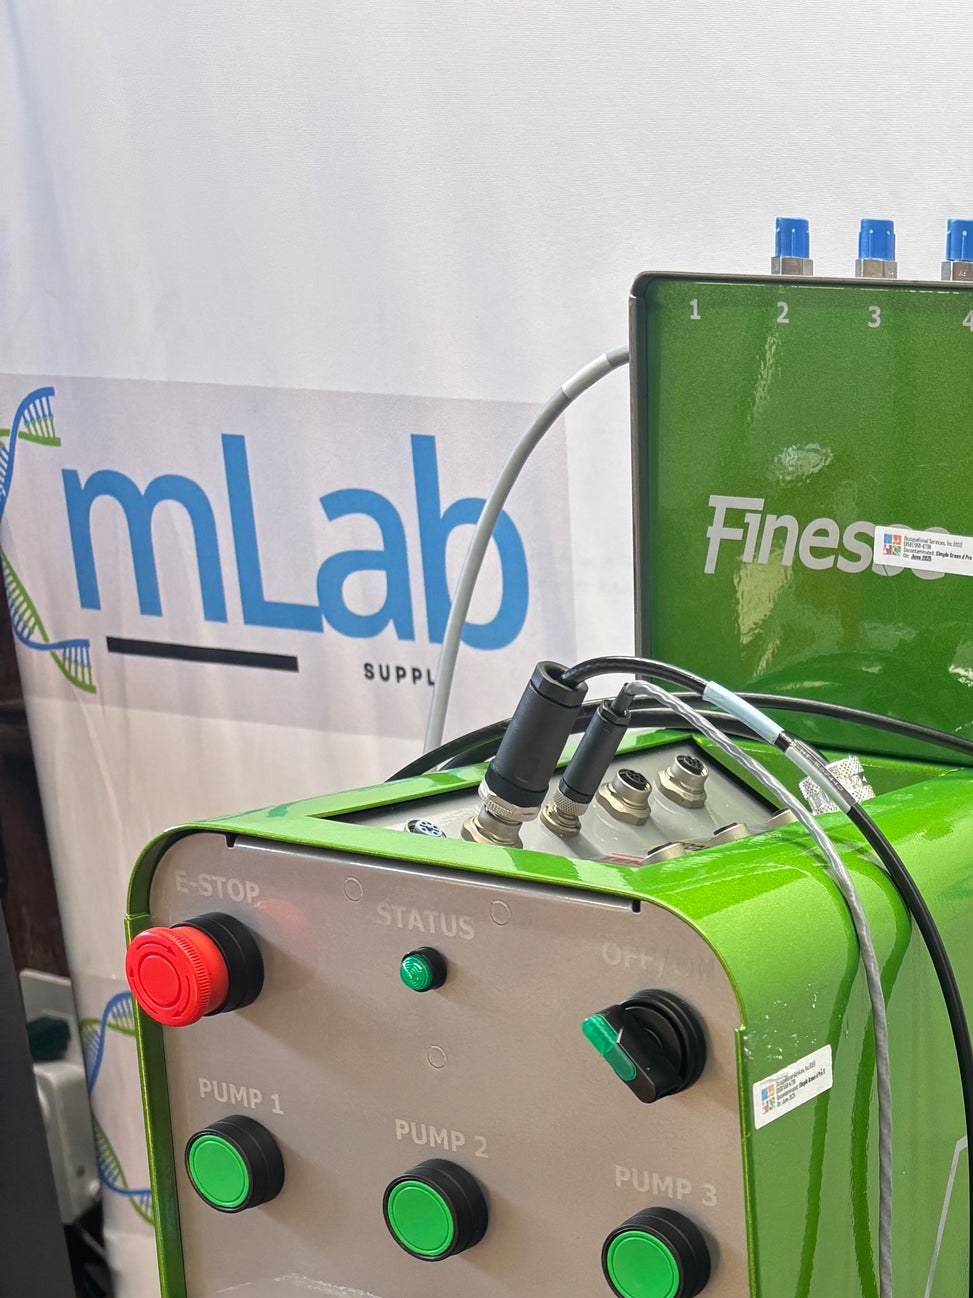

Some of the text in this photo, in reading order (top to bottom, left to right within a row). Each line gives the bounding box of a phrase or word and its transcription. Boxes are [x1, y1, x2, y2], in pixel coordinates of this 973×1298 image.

[688, 298, 701, 320] 1
[776, 302, 789, 324] 2
[867, 306, 882, 328] 3
[61, 433, 529, 651] mLab
[704, 494, 952, 580] Fines
[364, 661, 437, 687] SUPPL
[174, 869, 262, 904] E-STOP
[375, 900, 475, 941] STATUS
[199, 1077, 284, 1115] PUMP 1
[395, 1118, 489, 1159] PUMP 2
[614, 1164, 718, 1207] PUMP 3
